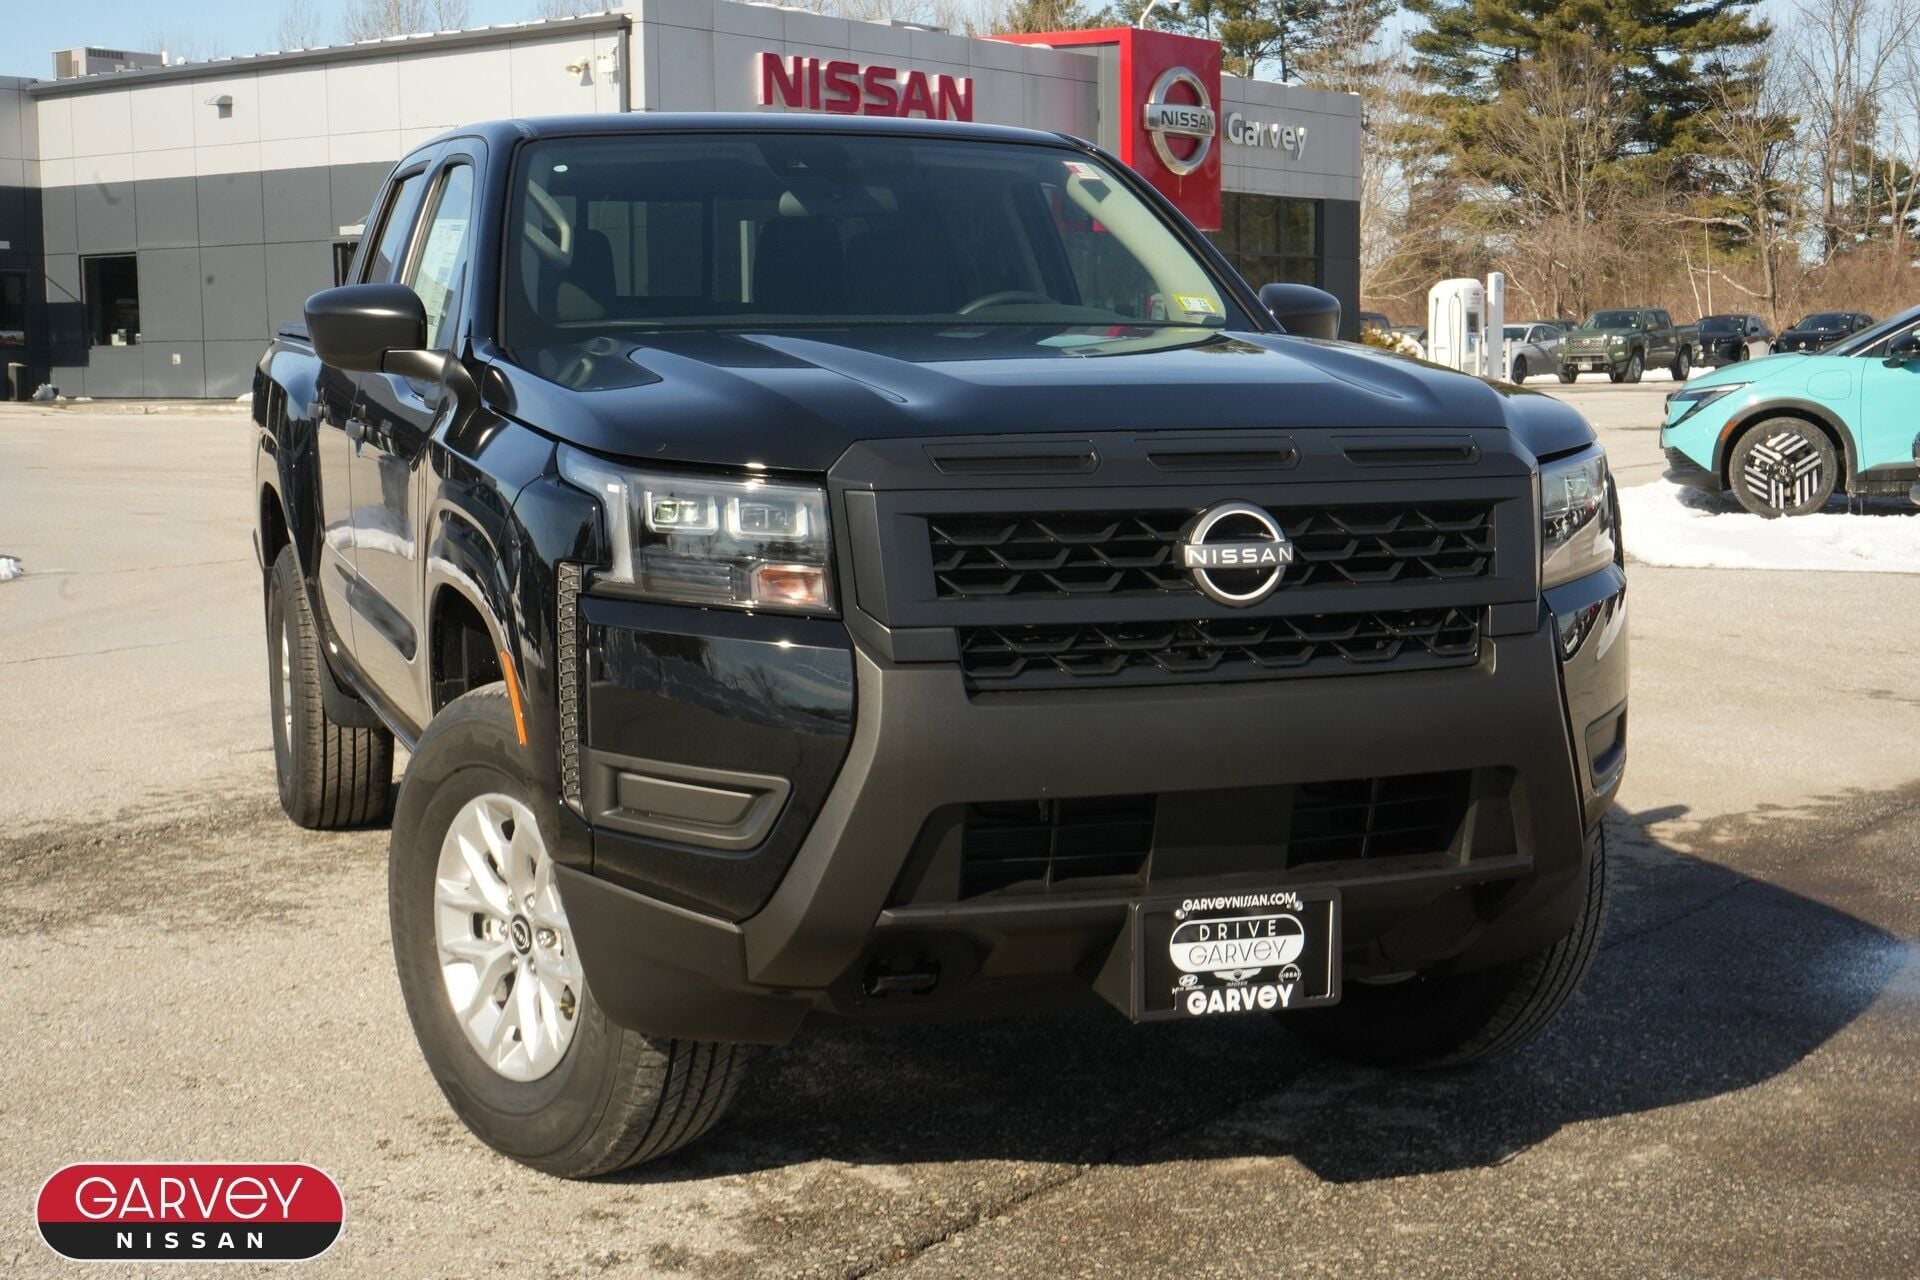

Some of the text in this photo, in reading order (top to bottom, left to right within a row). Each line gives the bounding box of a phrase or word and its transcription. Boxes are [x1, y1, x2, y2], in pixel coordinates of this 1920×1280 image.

[758, 52, 973, 122] NISSAN
[1161, 110, 1215, 130] NISSAN
[1226, 112, 1308, 160] Garvey
[1188, 546, 1292, 564] NISSAN
[1199, 919, 1277, 940] DRIVE
